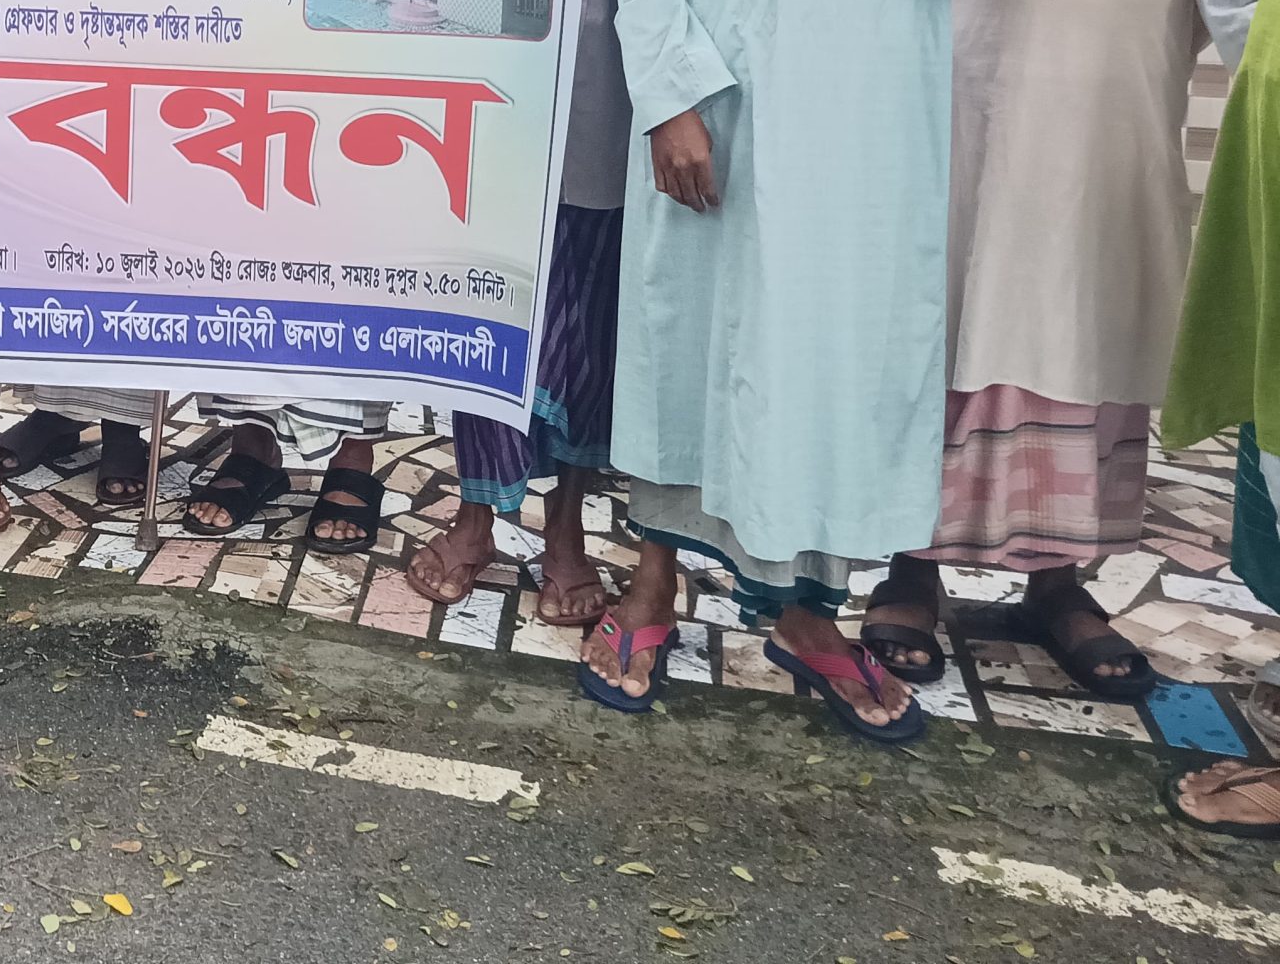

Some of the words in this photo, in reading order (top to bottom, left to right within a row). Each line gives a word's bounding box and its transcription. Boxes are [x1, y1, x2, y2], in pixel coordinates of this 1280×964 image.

[4, 4, 58, 36] গ্রেফতার
[64, 12, 75, 34] ও
[79, 2, 149, 50] দৃষ্টান্তমূলক
[194, 6, 243, 44] দাবীতে
[45, 243, 89, 273] তারিখ:
[96, 252, 115, 274] ১০
[120, 247, 158, 281] জুলাই
[164, 256, 205, 281] ২০২৬
[238, 257, 276, 283] রোজঃ
[282, 260, 335, 291] শুক্রবার,
[384, 267, 418, 297] দুপুর
[423, 273, 460, 296] ২.৫০
[10, 297, 94, 348] মসজিদ)
[100, 300, 190, 344] সর্বস্তরের
[196, 304, 276, 352] তৌহিদী
[282, 318, 345, 354] জনতা
[352, 327, 370, 352] ও
